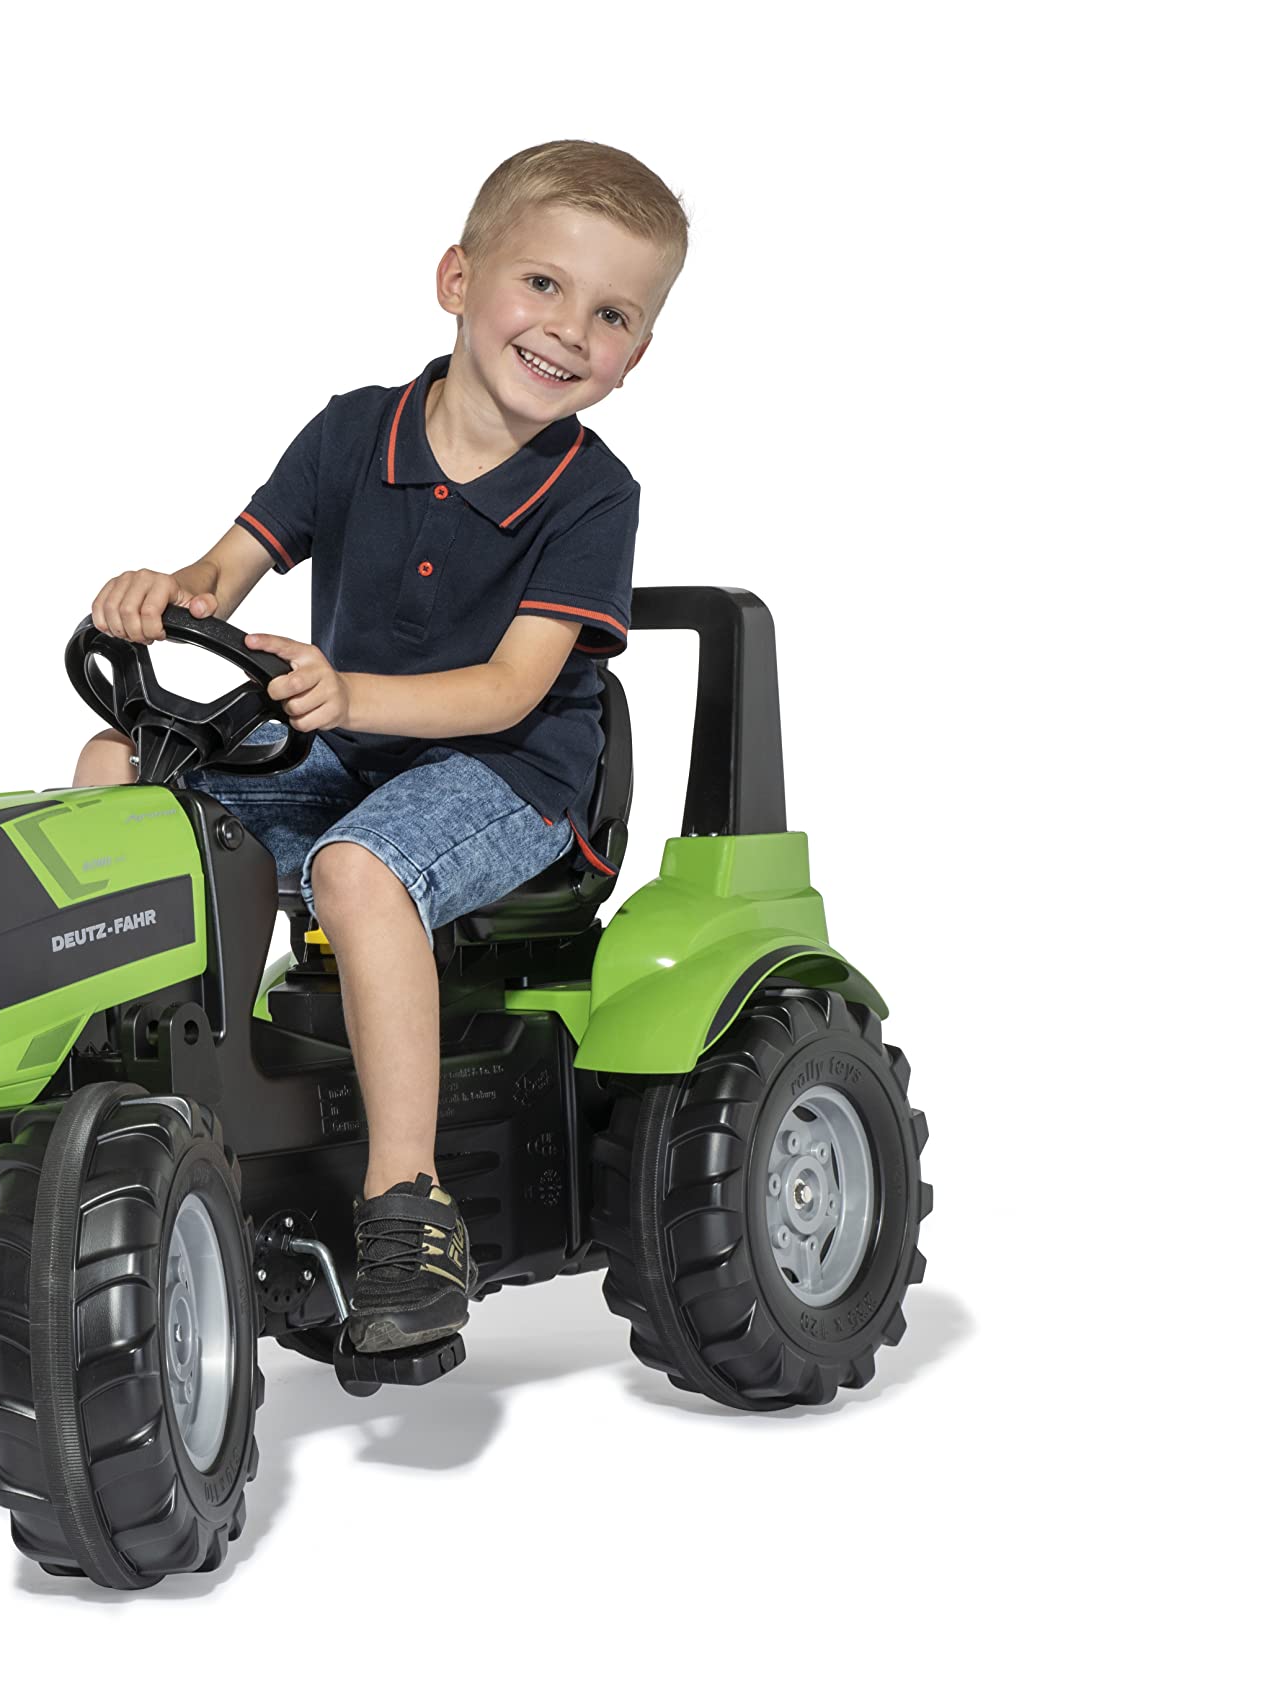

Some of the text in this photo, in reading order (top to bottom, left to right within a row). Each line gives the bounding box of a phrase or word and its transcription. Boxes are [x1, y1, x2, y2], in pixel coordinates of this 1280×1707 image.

[51, 909, 157, 953] DEUTZ-FAHR
[790, 1055, 864, 1097] rolly toys
[447, 1217, 465, 1269] FILA
